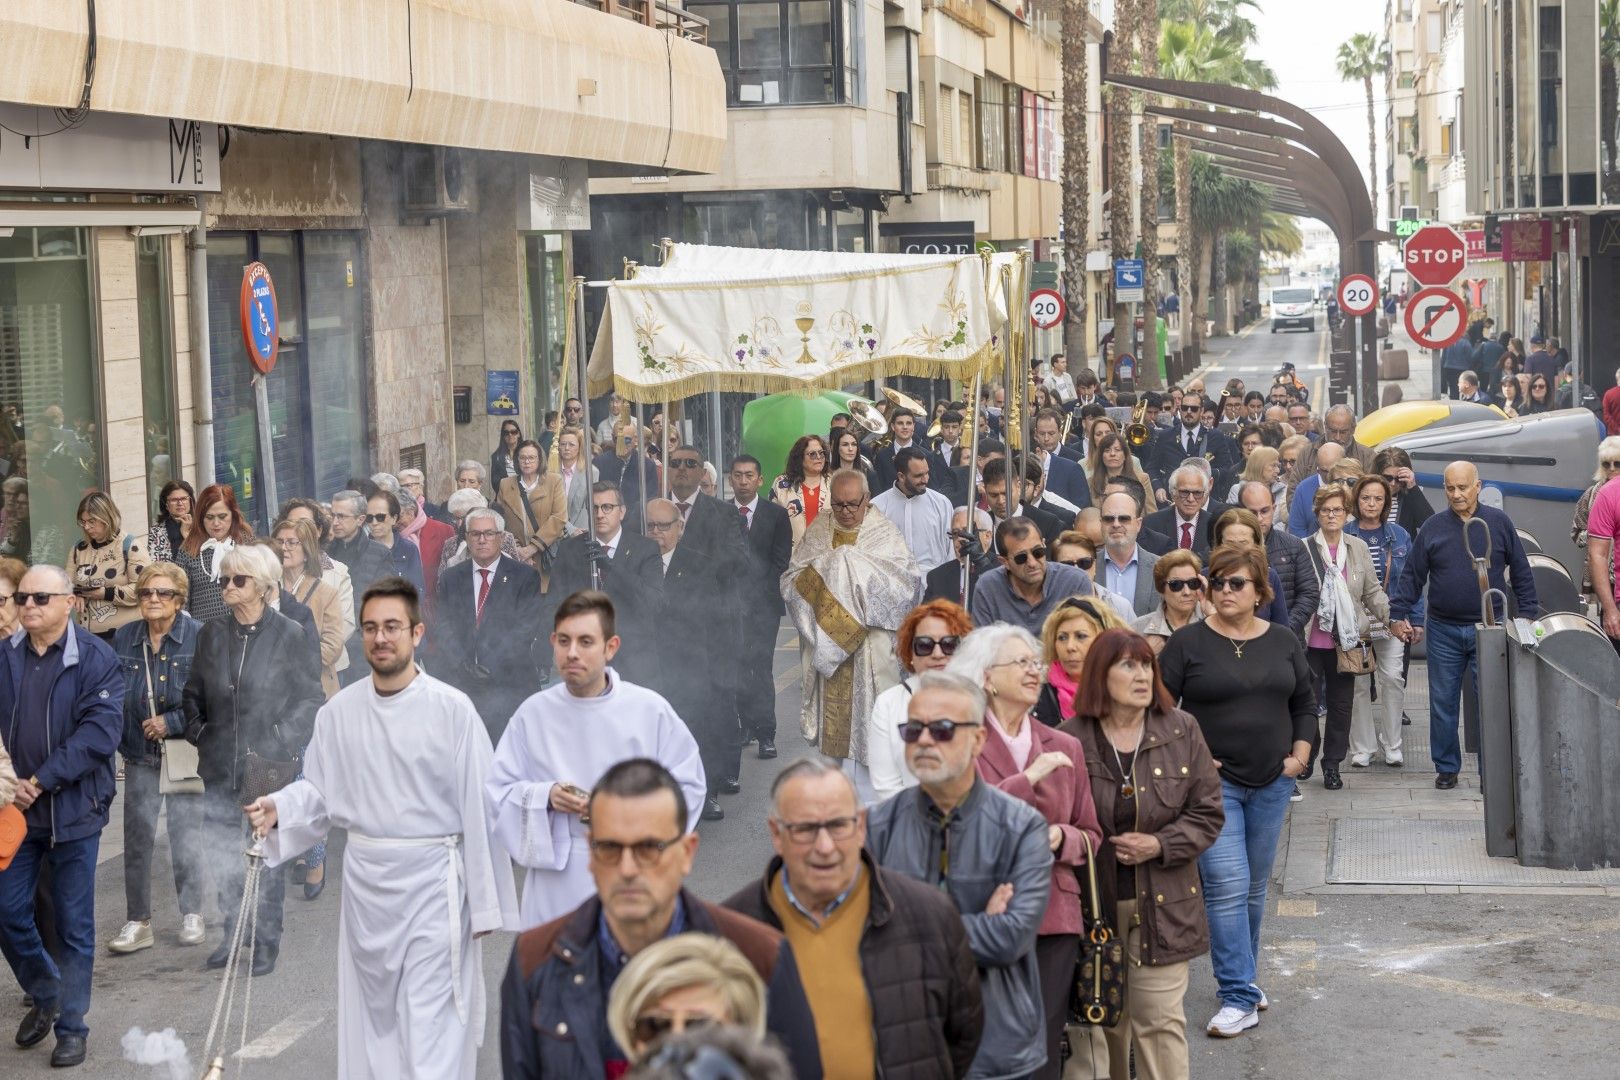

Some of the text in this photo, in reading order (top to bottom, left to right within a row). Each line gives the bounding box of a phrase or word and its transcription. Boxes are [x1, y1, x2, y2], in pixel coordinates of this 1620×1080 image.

[1407, 249, 1463, 264] STOP
[1347, 289, 1369, 302] 20
[1034, 302, 1057, 315] 20
